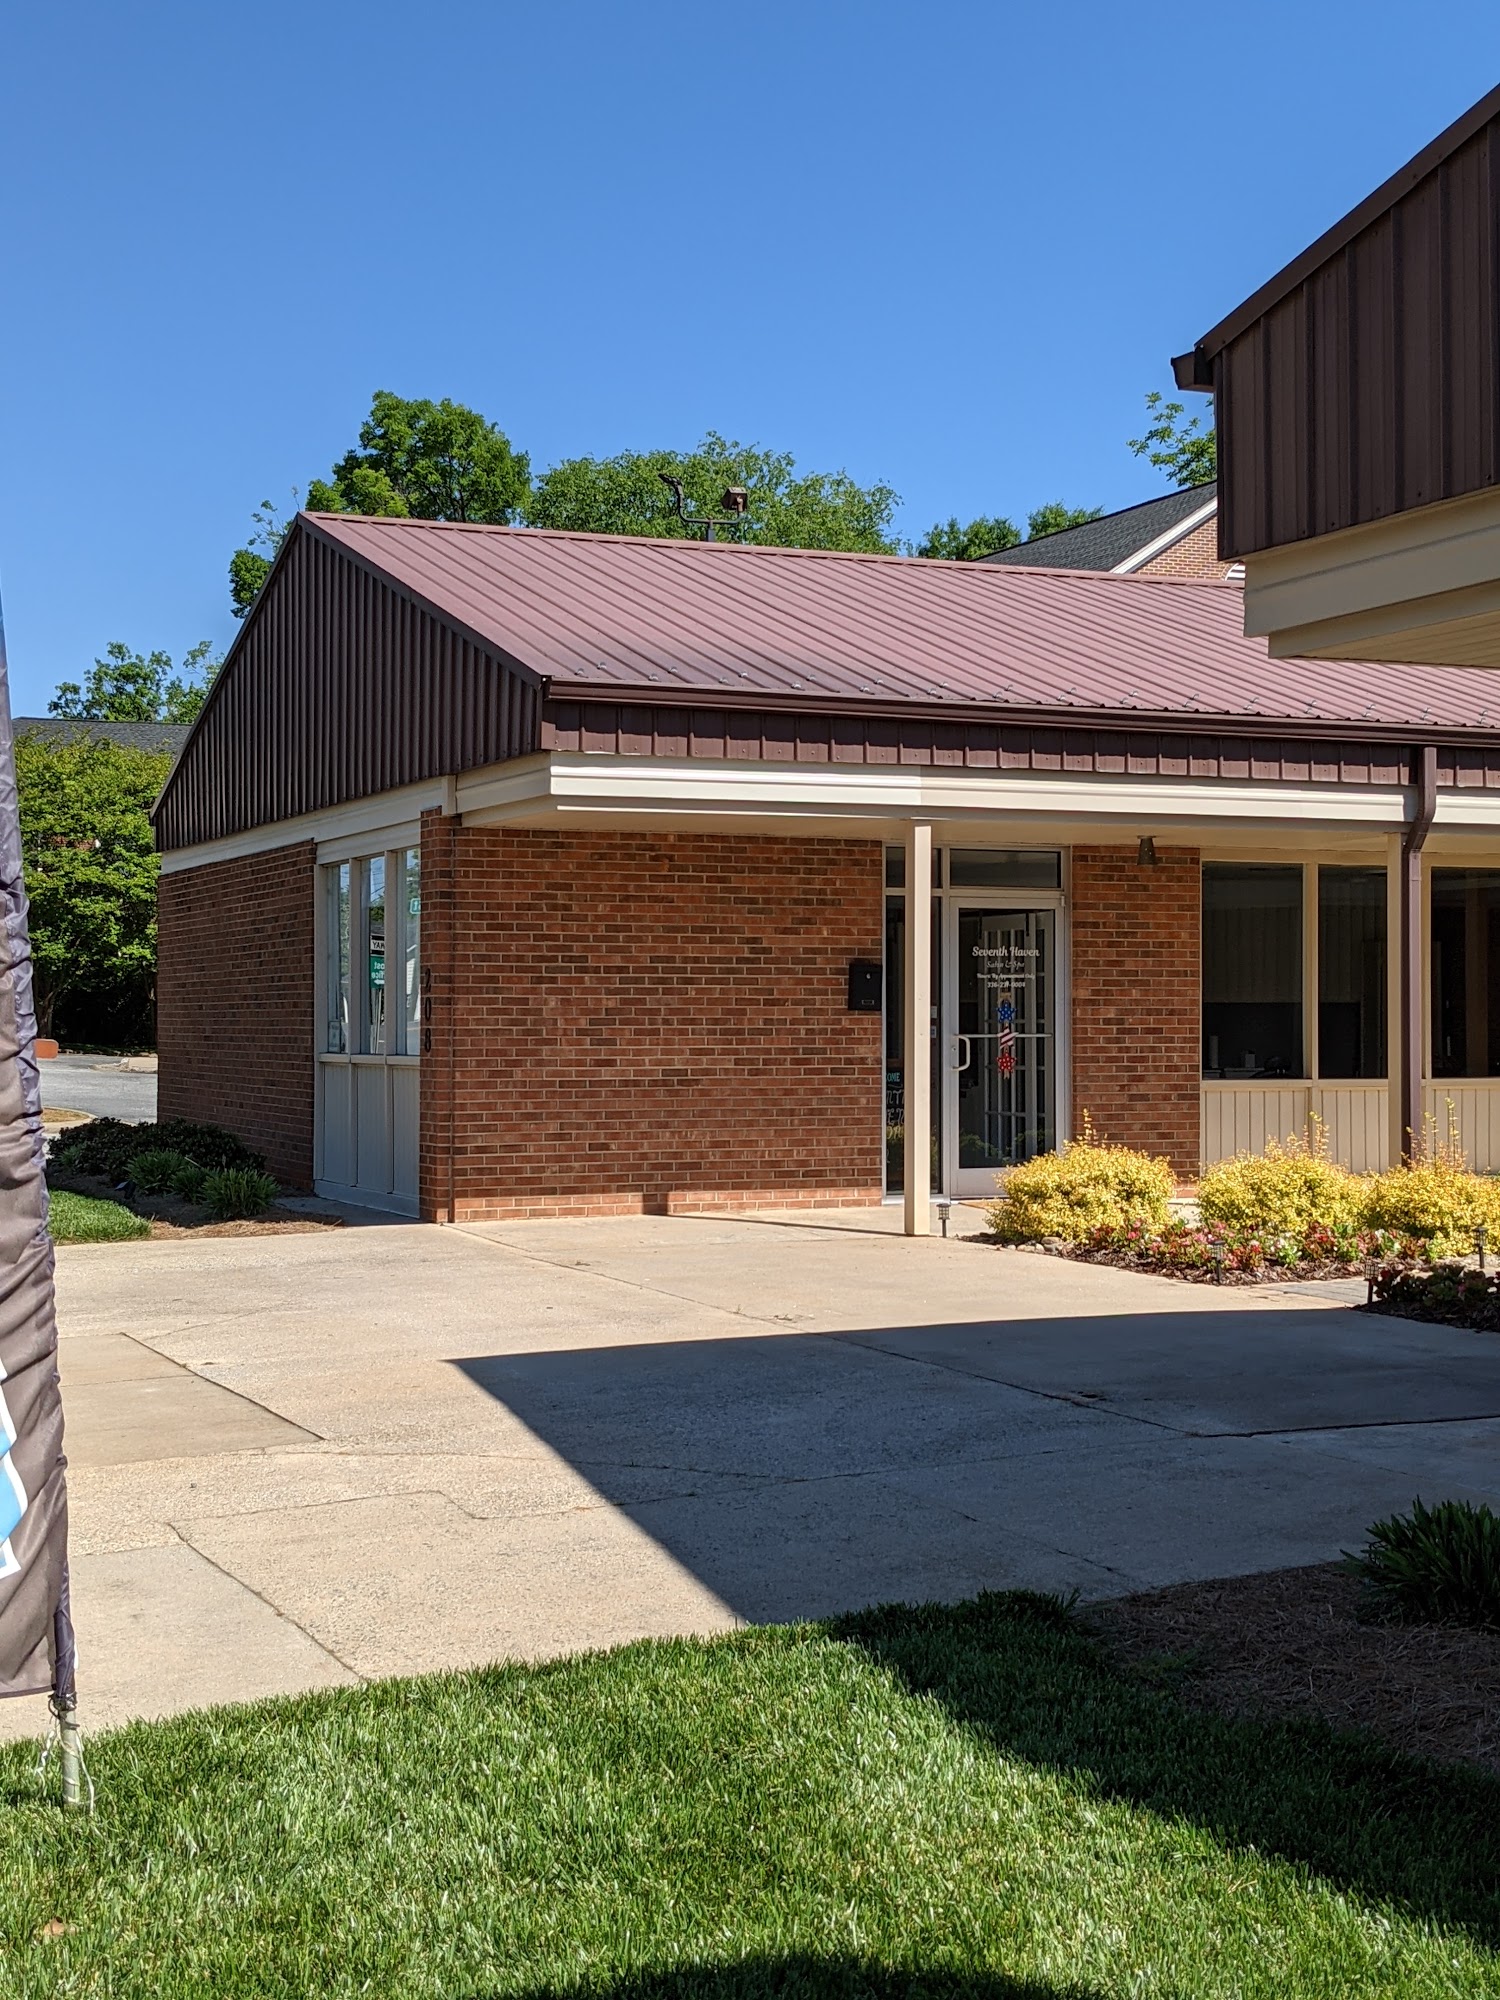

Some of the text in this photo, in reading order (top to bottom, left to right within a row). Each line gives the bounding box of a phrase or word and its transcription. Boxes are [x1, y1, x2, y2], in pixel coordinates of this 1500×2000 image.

[972, 946, 1040, 956] Seventh Haven
[1013, 961, 1024, 970] Spa
